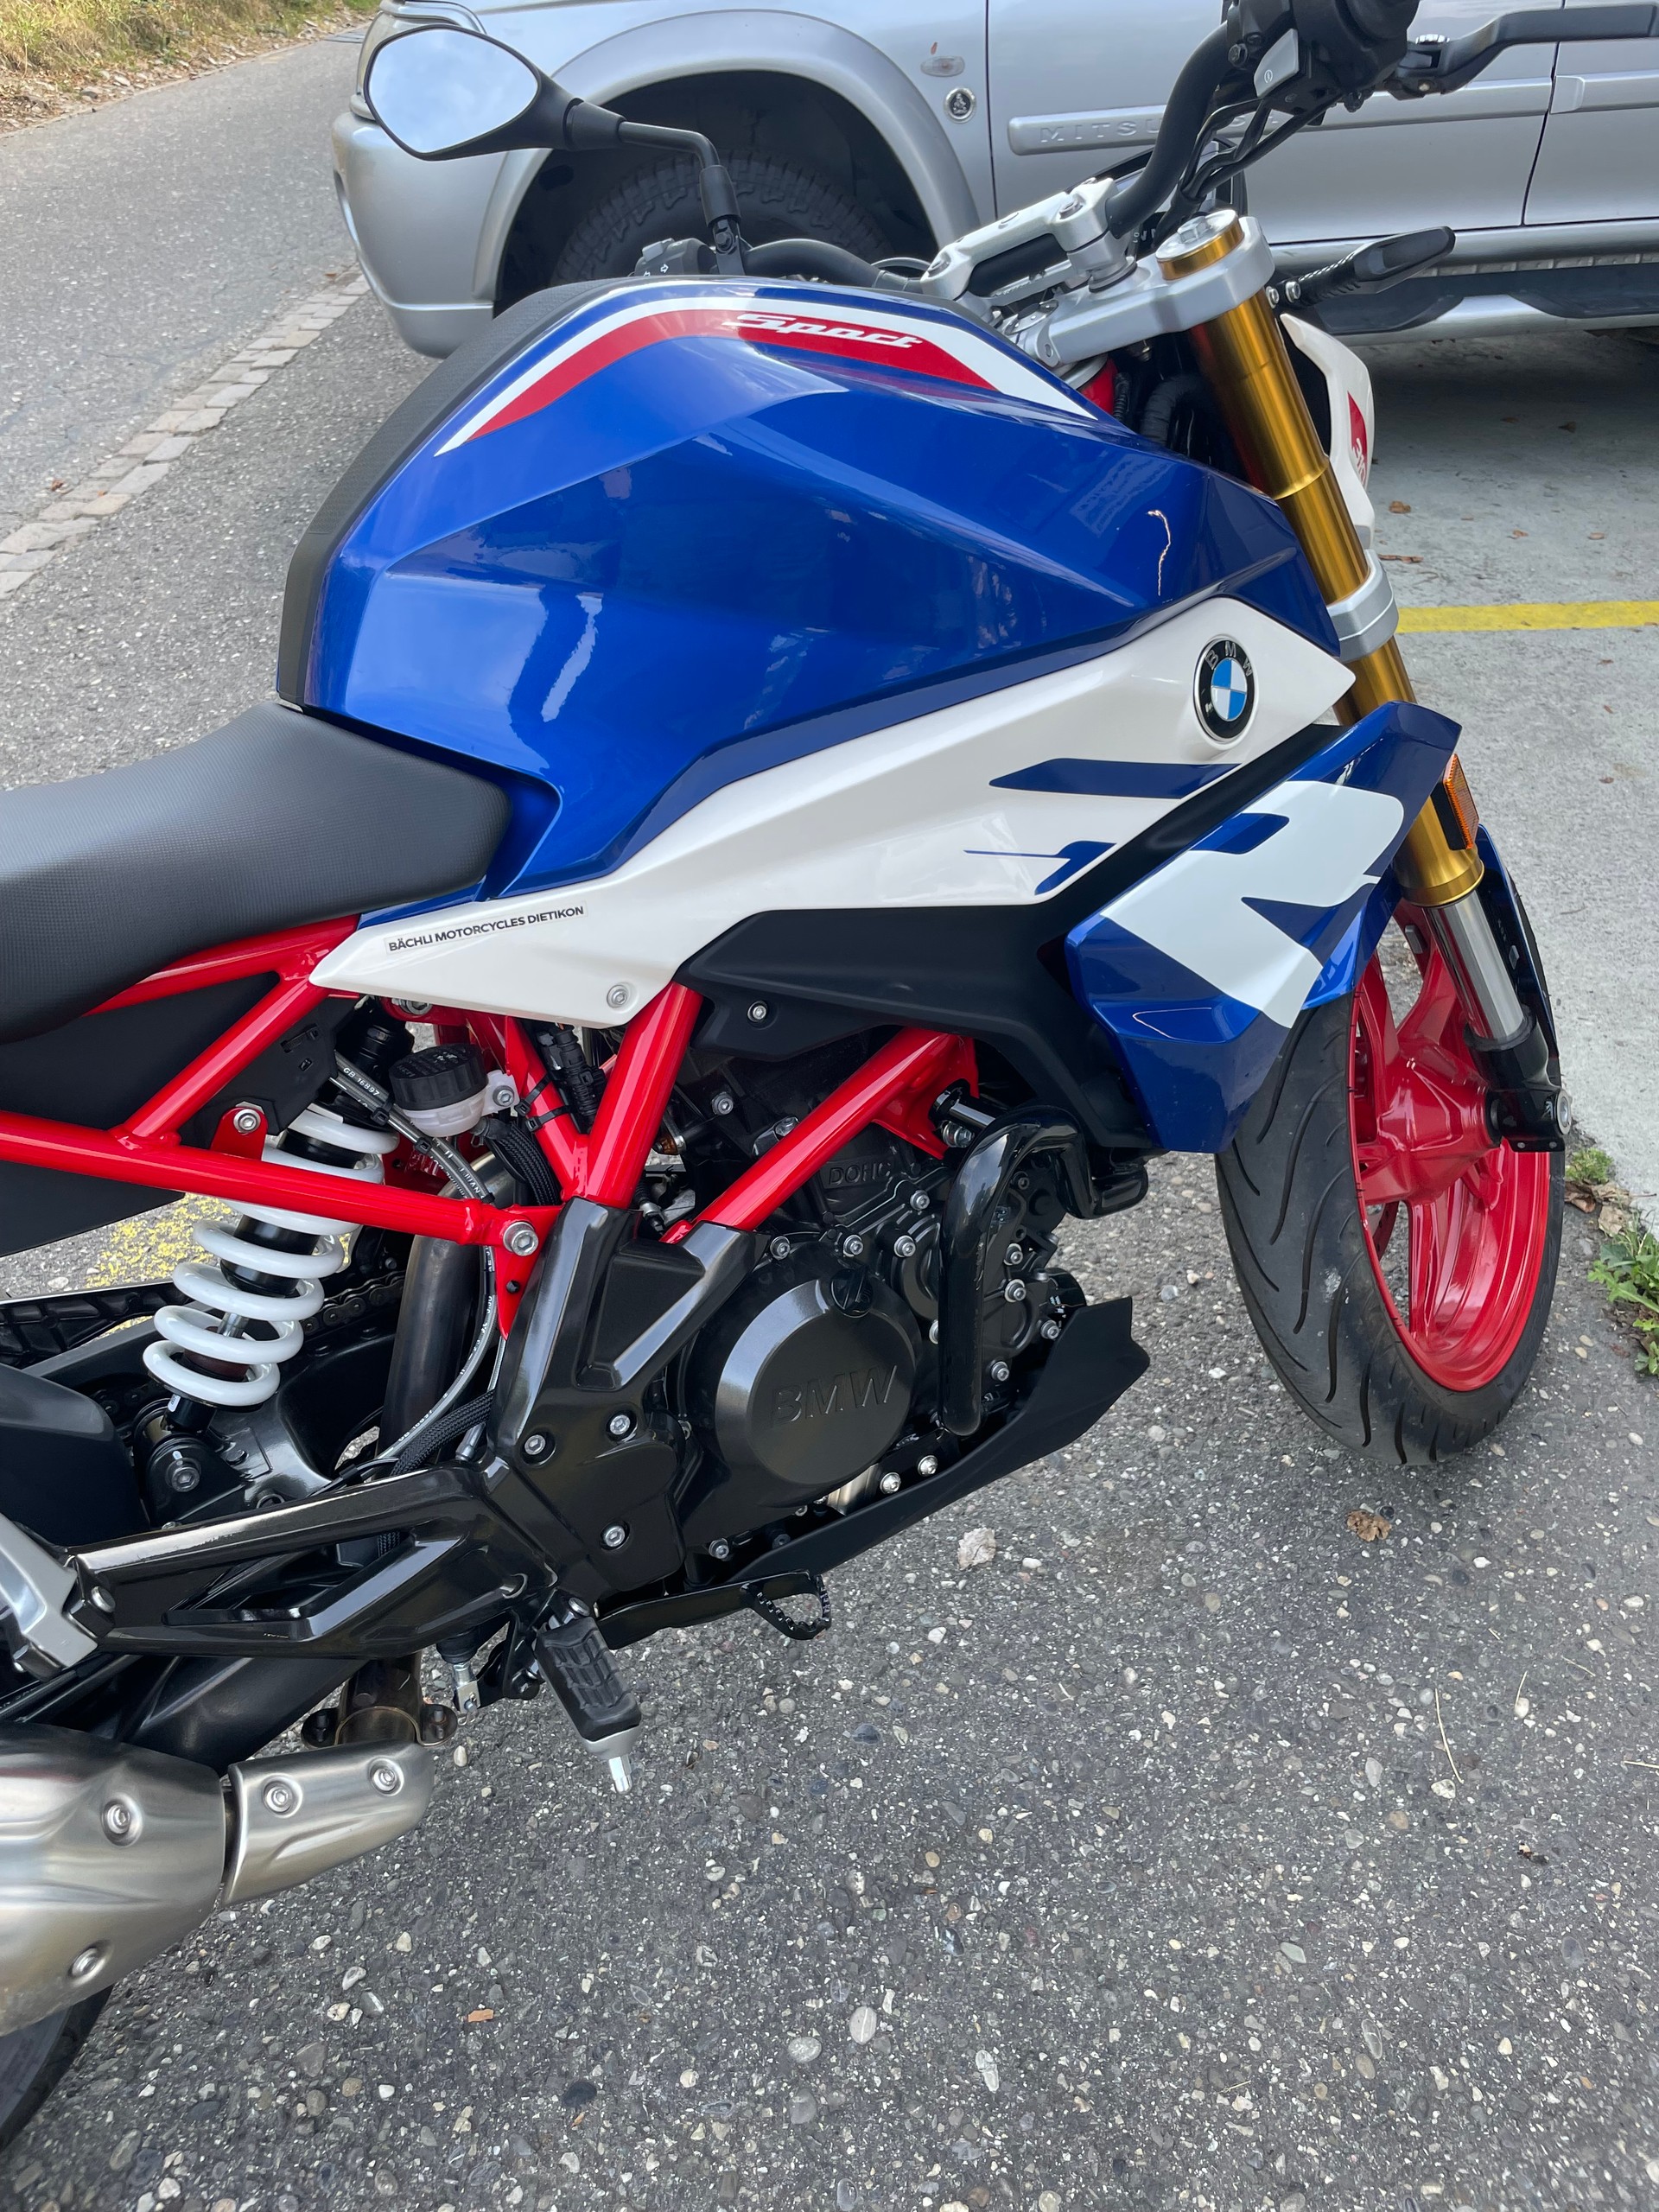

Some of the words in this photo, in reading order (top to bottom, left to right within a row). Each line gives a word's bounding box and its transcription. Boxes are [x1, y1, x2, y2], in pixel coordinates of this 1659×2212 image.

[721, 313, 924, 349] Sport
[1205, 640, 1254, 677] BMW
[389, 934, 433, 951] BÄCHLI
[435, 917, 525, 942] MOTORCYCLES
[528, 906, 584, 924] DIETIKON
[343, 1066, 355, 1078] GB
[357, 1077, 380, 1096] 16897
[829, 1162, 892, 1185] DOHC
[772, 1364, 898, 1423] BMW
